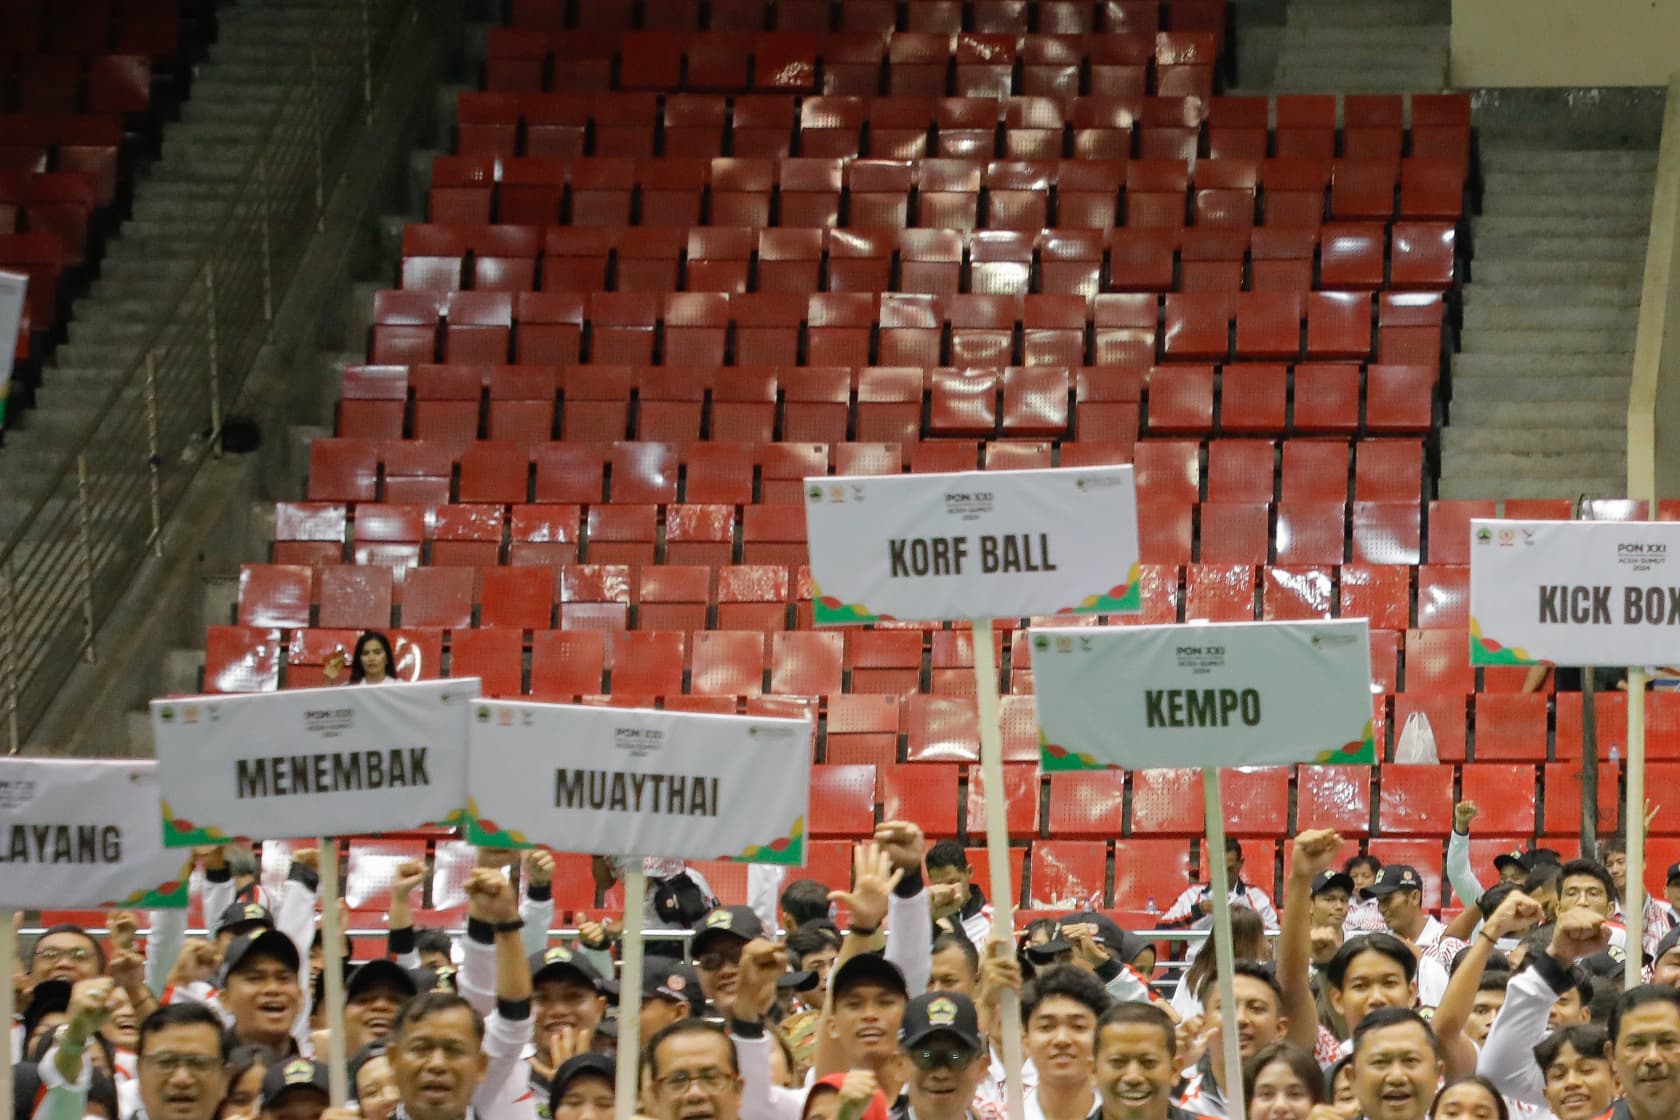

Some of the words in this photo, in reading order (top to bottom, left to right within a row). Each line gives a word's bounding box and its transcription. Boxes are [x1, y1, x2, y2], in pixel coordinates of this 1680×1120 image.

[889, 536, 967, 578] KORF
[980, 533, 1057, 574] BALL
[1618, 544, 1643, 553] PON
[1539, 585, 1612, 625] KICK
[1145, 688, 1261, 728] KEMPO
[236, 747, 430, 799] MENEMBAK
[555, 768, 720, 817] MUAYTHAI
